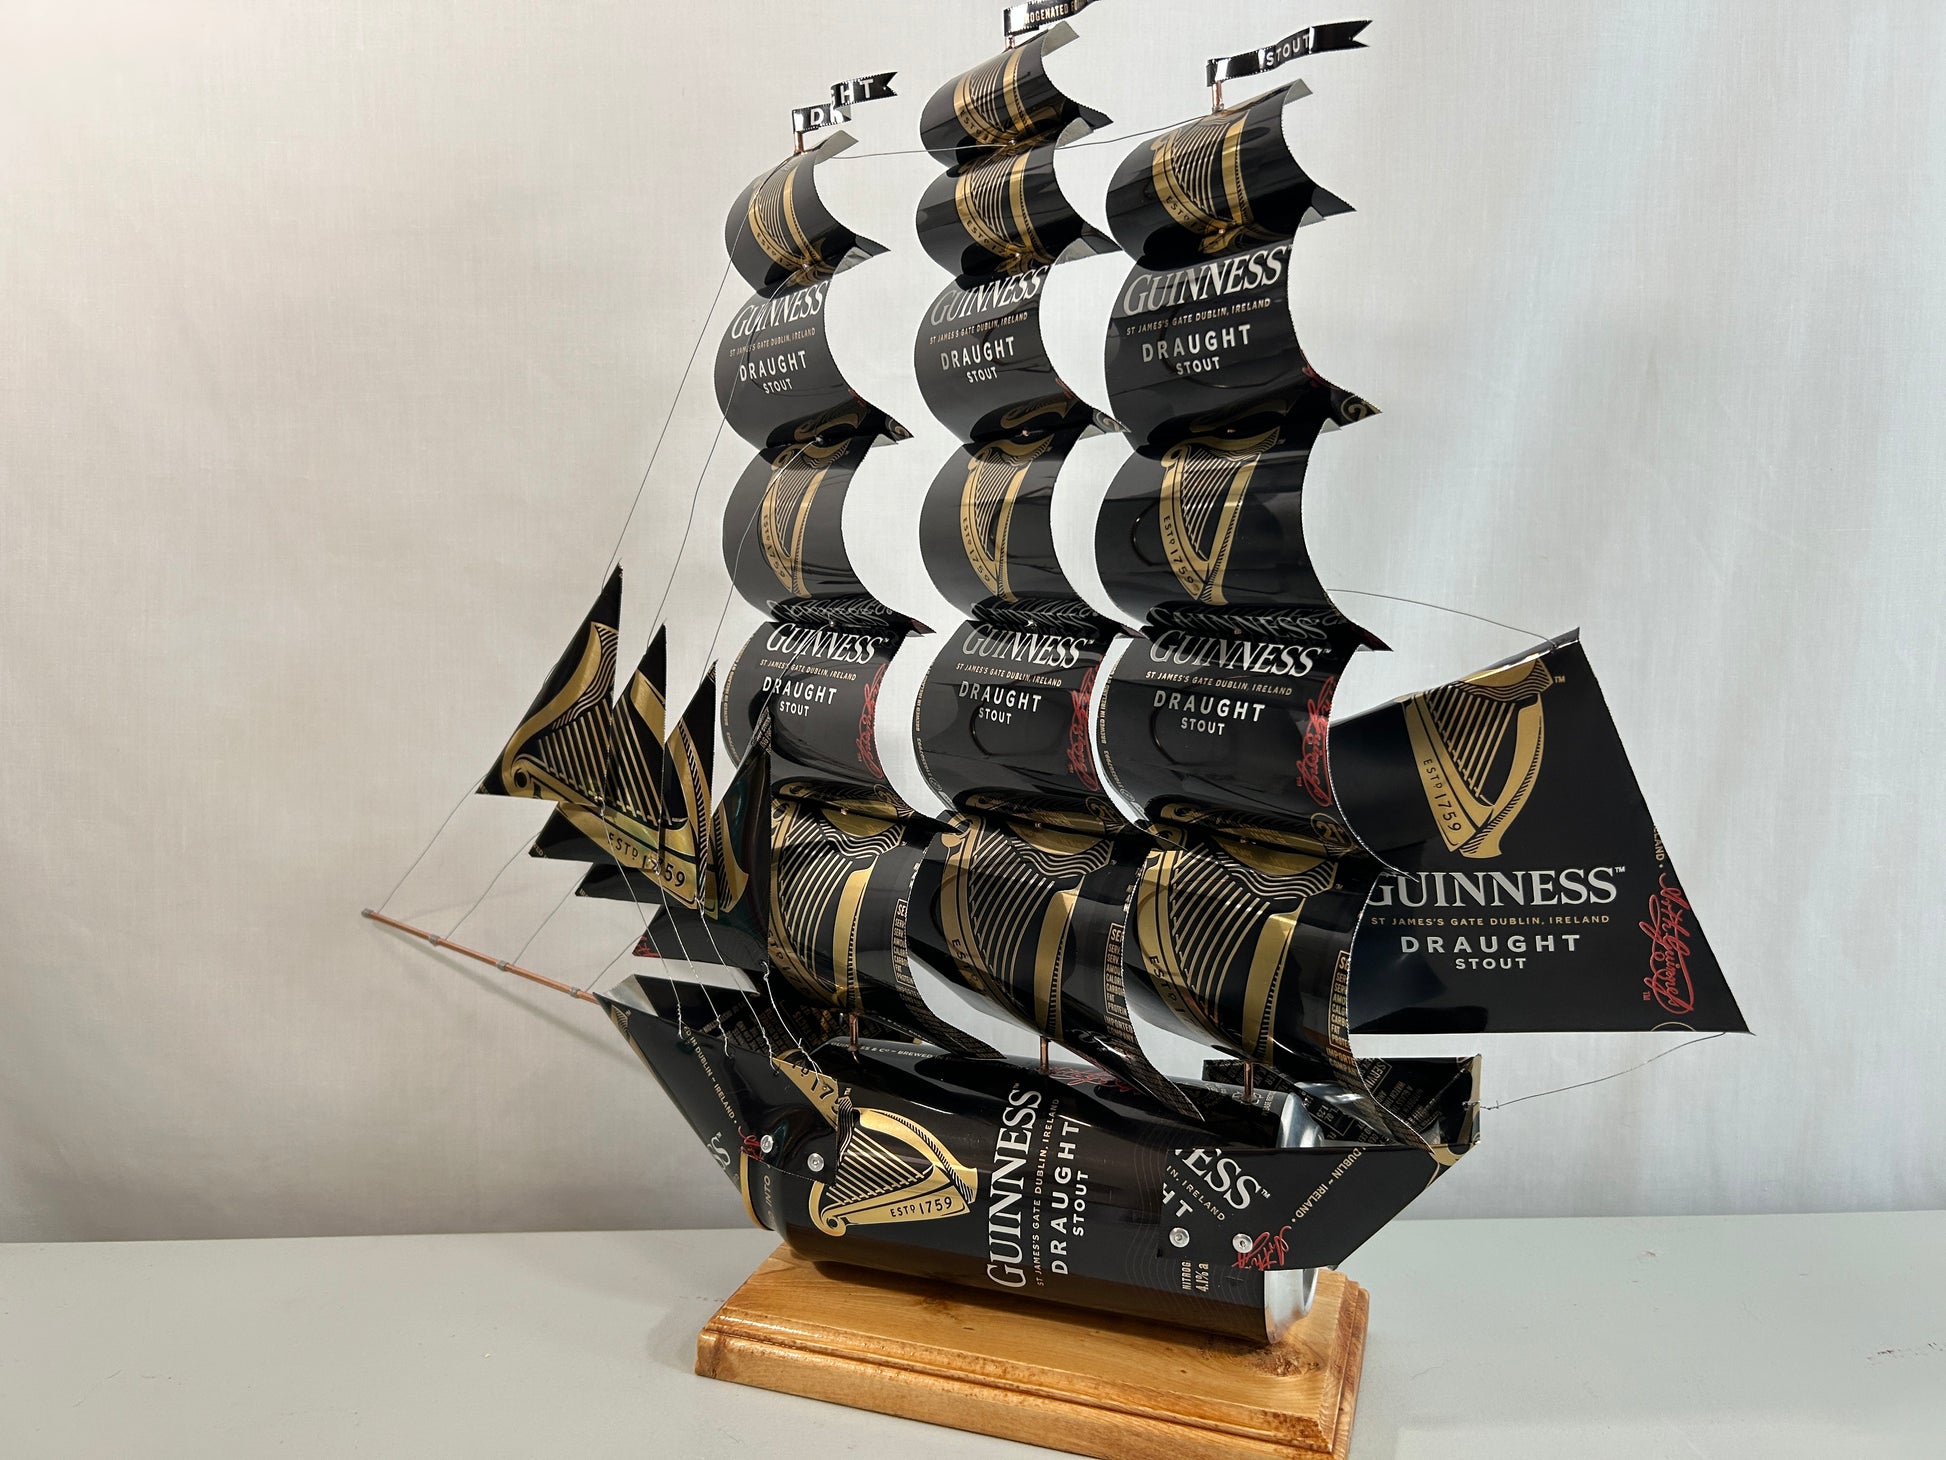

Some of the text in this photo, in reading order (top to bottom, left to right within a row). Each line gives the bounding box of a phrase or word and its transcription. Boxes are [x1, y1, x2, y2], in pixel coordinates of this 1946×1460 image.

[1266, 34, 1310, 66] STOUT
[960, 326, 975, 337] GATE
[1001, 312, 1028, 326] IRELAND
[1126, 327, 1136, 336] ST
[1172, 314, 1192, 327] GATE
[1232, 298, 1271, 314] IRELAND
[940, 336, 1015, 371] DRAUGHT
[1142, 324, 1250, 362] DRAUGHT
[740, 350, 806, 382] DRAUGHT
[967, 366, 998, 383] STOUT
[1176, 356, 1220, 376] STOUT
[763, 378, 792, 394] STOUT
[766, 545, 785, 578] 1759
[969, 549, 990, 582] 1759
[1170, 549, 1194, 584] 1759
[762, 677, 837, 704] DRAUGHT
[990, 668, 1005, 677] GATE
[1033, 676, 1061, 687] IRELAND
[1145, 671, 1155, 679] ST
[1192, 676, 1212, 686] GATE
[1216, 679, 1249, 691] DUBLIN,
[1252, 684, 1292, 696] IRELAND
[780, 701, 809, 716] STOUT
[959, 681, 1042, 712] DRAUGHT
[1154, 690, 1265, 722] DRAUGHT
[979, 707, 1011, 724] STOUT
[1181, 717, 1224, 735] STOUT
[1435, 794, 1462, 831] 1759
[1371, 915, 1610, 926] ST JAMES'S GATE DUBLIN, IRELAND
[1401, 934, 1580, 954] DRAUGHT
[1456, 958, 1527, 970] STOUT
[696, 1046, 712, 1076] DUBLIN
[714, 1084, 735, 1118] IRELAND
[1032, 1099, 1060, 1286] ST JAMES'S GATE DUBLIN, IRELAND
[1050, 1122, 1080, 1275] DRAUGHT
[1295, 1148, 1362, 1218] DUBLIN IRELAND
[919, 1197, 952, 1215] 1759
[1072, 1170, 1090, 1236] STOUT
[1181, 1180, 1226, 1220] IRELAND
